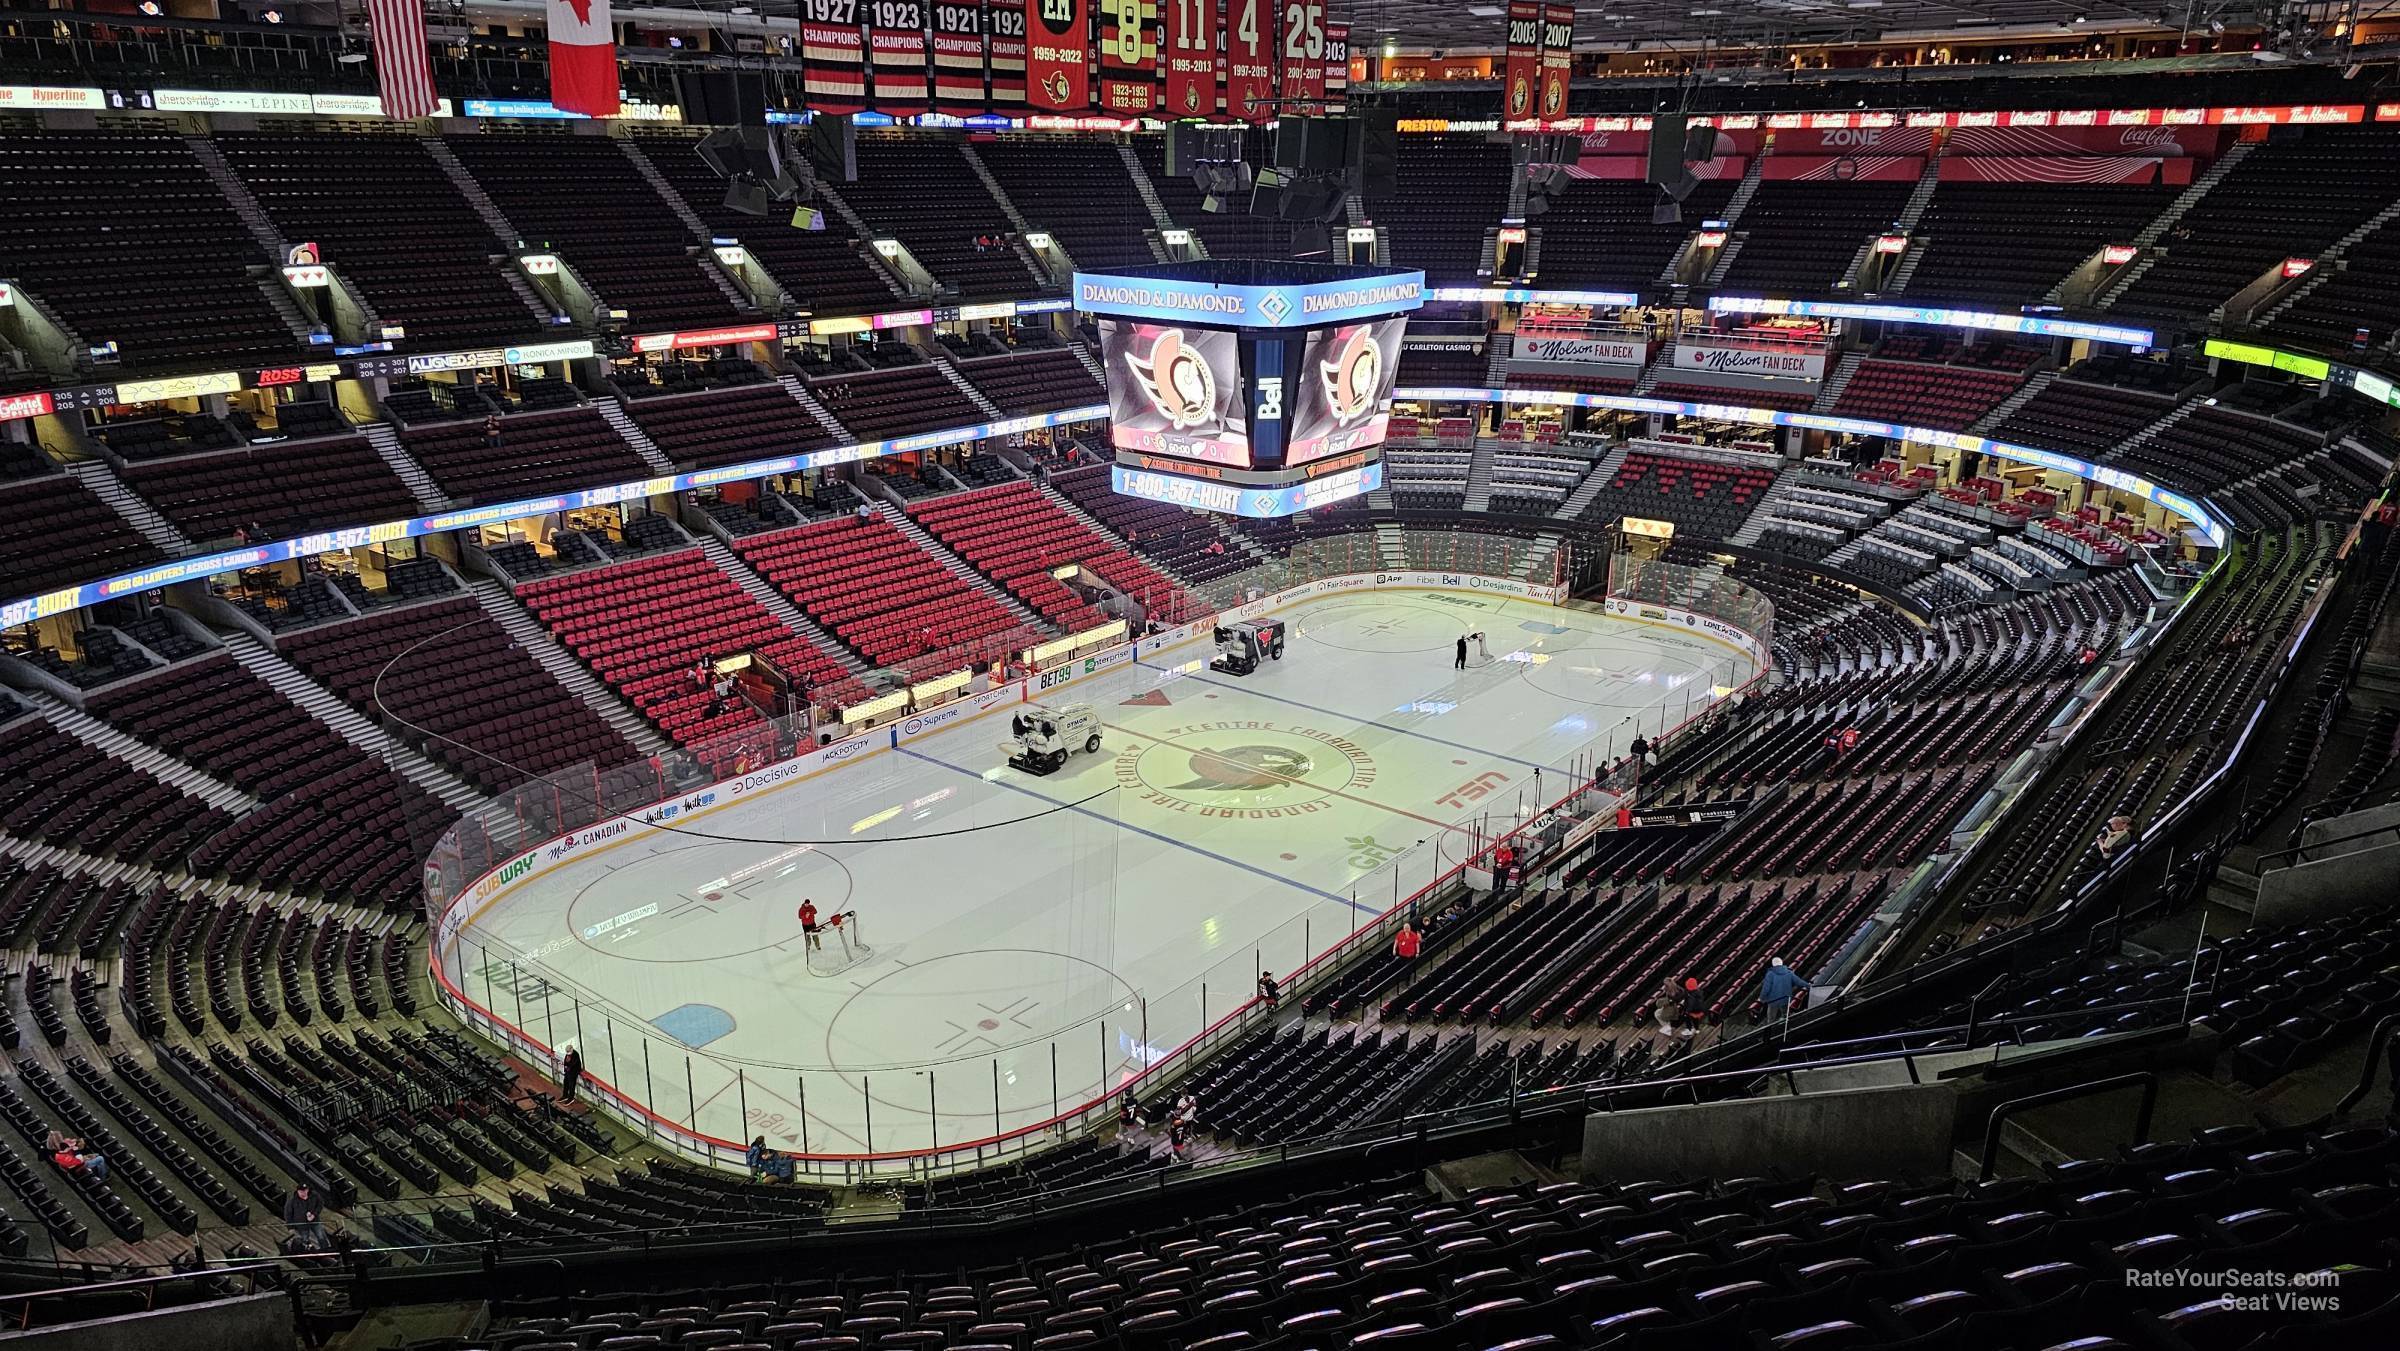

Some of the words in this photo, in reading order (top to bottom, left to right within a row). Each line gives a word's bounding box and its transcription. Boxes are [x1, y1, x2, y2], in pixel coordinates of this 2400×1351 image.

[805, 0, 856, 23] 1927
[872, 1, 920, 29] 1923
[936, 5, 979, 33] 1921
[1043, 0, 1071, 21] EM
[992, 10, 1025, 36] 192
[1117, 0, 1142, 64] 8
[1177, 0, 1207, 50] 11
[1238, 0, 1259, 57] 4
[1286, 3, 1324, 60] 25
[1509, 20, 1536, 44] 2003
[803, 28, 861, 46] CHAMPIONS
[872, 35, 924, 50] CHAMPIONS
[1544, 24, 1572, 47] 2007
[934, 37, 982, 53] CHAMPIONS
[992, 41, 1025, 55] CHAMPIO
[1032, 46, 1082, 64] 1959-2022
[1171, 58, 1212, 73] 1995-2013
[1232, 65, 1268, 78] 1997-2015
[1287, 67, 1321, 79] 2001-2017
[1325, 66, 1347, 77] MPIONS
[32, 88, 87, 103] Hyperline
[1112, 84, 1148, 97] 1923-1931
[1112, 96, 1148, 109] 1932-1933
[619, 103, 682, 121] SIGNS.CA
[1396, 120, 1448, 132] PRESTON
[1447, 120, 1499, 131] HARDWARE
[1820, 129, 1882, 146] ZONE
[2119, 126, 2176, 146] Coca-Cola
[1082, 284, 1151, 306] DIAMOND
[1152, 290, 1166, 307] &
[1302, 291, 1358, 313] DIAMOND
[1358, 289, 1368, 306] &
[523, 350, 555, 359] KONICA
[556, 345, 591, 356] MINOLTA
[1409, 343, 1445, 352] CARLETON
[1445, 344, 1471, 352] CASINO
[1539, 340, 1594, 359] Molson
[1594, 345, 1610, 358] FAN
[1611, 345, 1634, 359] DECK
[411, 354, 467, 371] ALIGNED
[1705, 350, 1761, 372] Molson
[1762, 356, 1780, 370] FAN
[1781, 358, 1806, 372] DECK
[259, 368, 301, 382] ROSS
[393, 367, 407, 375] 207
[54, 391, 73, 401] 305
[95, 388, 113, 396] 306
[98, 396, 116, 406] 206
[1257, 377, 1283, 420] Bell
[56, 401, 75, 410] 205
[582, 476, 677, 507] 1-800-567-HURT
[1122, 472, 1242, 511] 1-800-567-HURT
[464, 509, 501, 523] LAWYERS
[286, 521, 410, 559] 1-800-567-HURT
[306, 556, 319, 564] 104
[108, 580, 132, 594] OVER
[131, 577, 145, 588] 60
[144, 565, 186, 584] LAWYERS
[185, 557, 223, 573] ACROSS
[222, 551, 260, 568] CANADA
[1416, 575, 1436, 585] Fibe
[1442, 574, 1461, 586] Bell
[148, 588, 161, 597] 103
[1326, 578, 1364, 590] FairSquare
[1482, 579, 1523, 594] Desjardins
[1527, 585, 1543, 599] Tim
[0, 586, 82, 627] 567-HURT
[1200, 615, 1220, 634] SKIP
[1086, 650, 1130, 673] enterprise
[1040, 665, 1072, 690] BET99
[973, 687, 1010, 705] SPORTCHEK
[907, 721, 921, 731] Esso
[923, 708, 958, 727] Supreme
[1066, 716, 1088, 729] DYMON
[822, 739, 870, 763] JACKPOTCITY
[745, 764, 799, 790] Decisive
[1434, 771, 1511, 809] TSN
[583, 821, 628, 846] CANADIAN
[1347, 846, 1407, 871] GFL
[475, 851, 538, 905] SUBWAY
